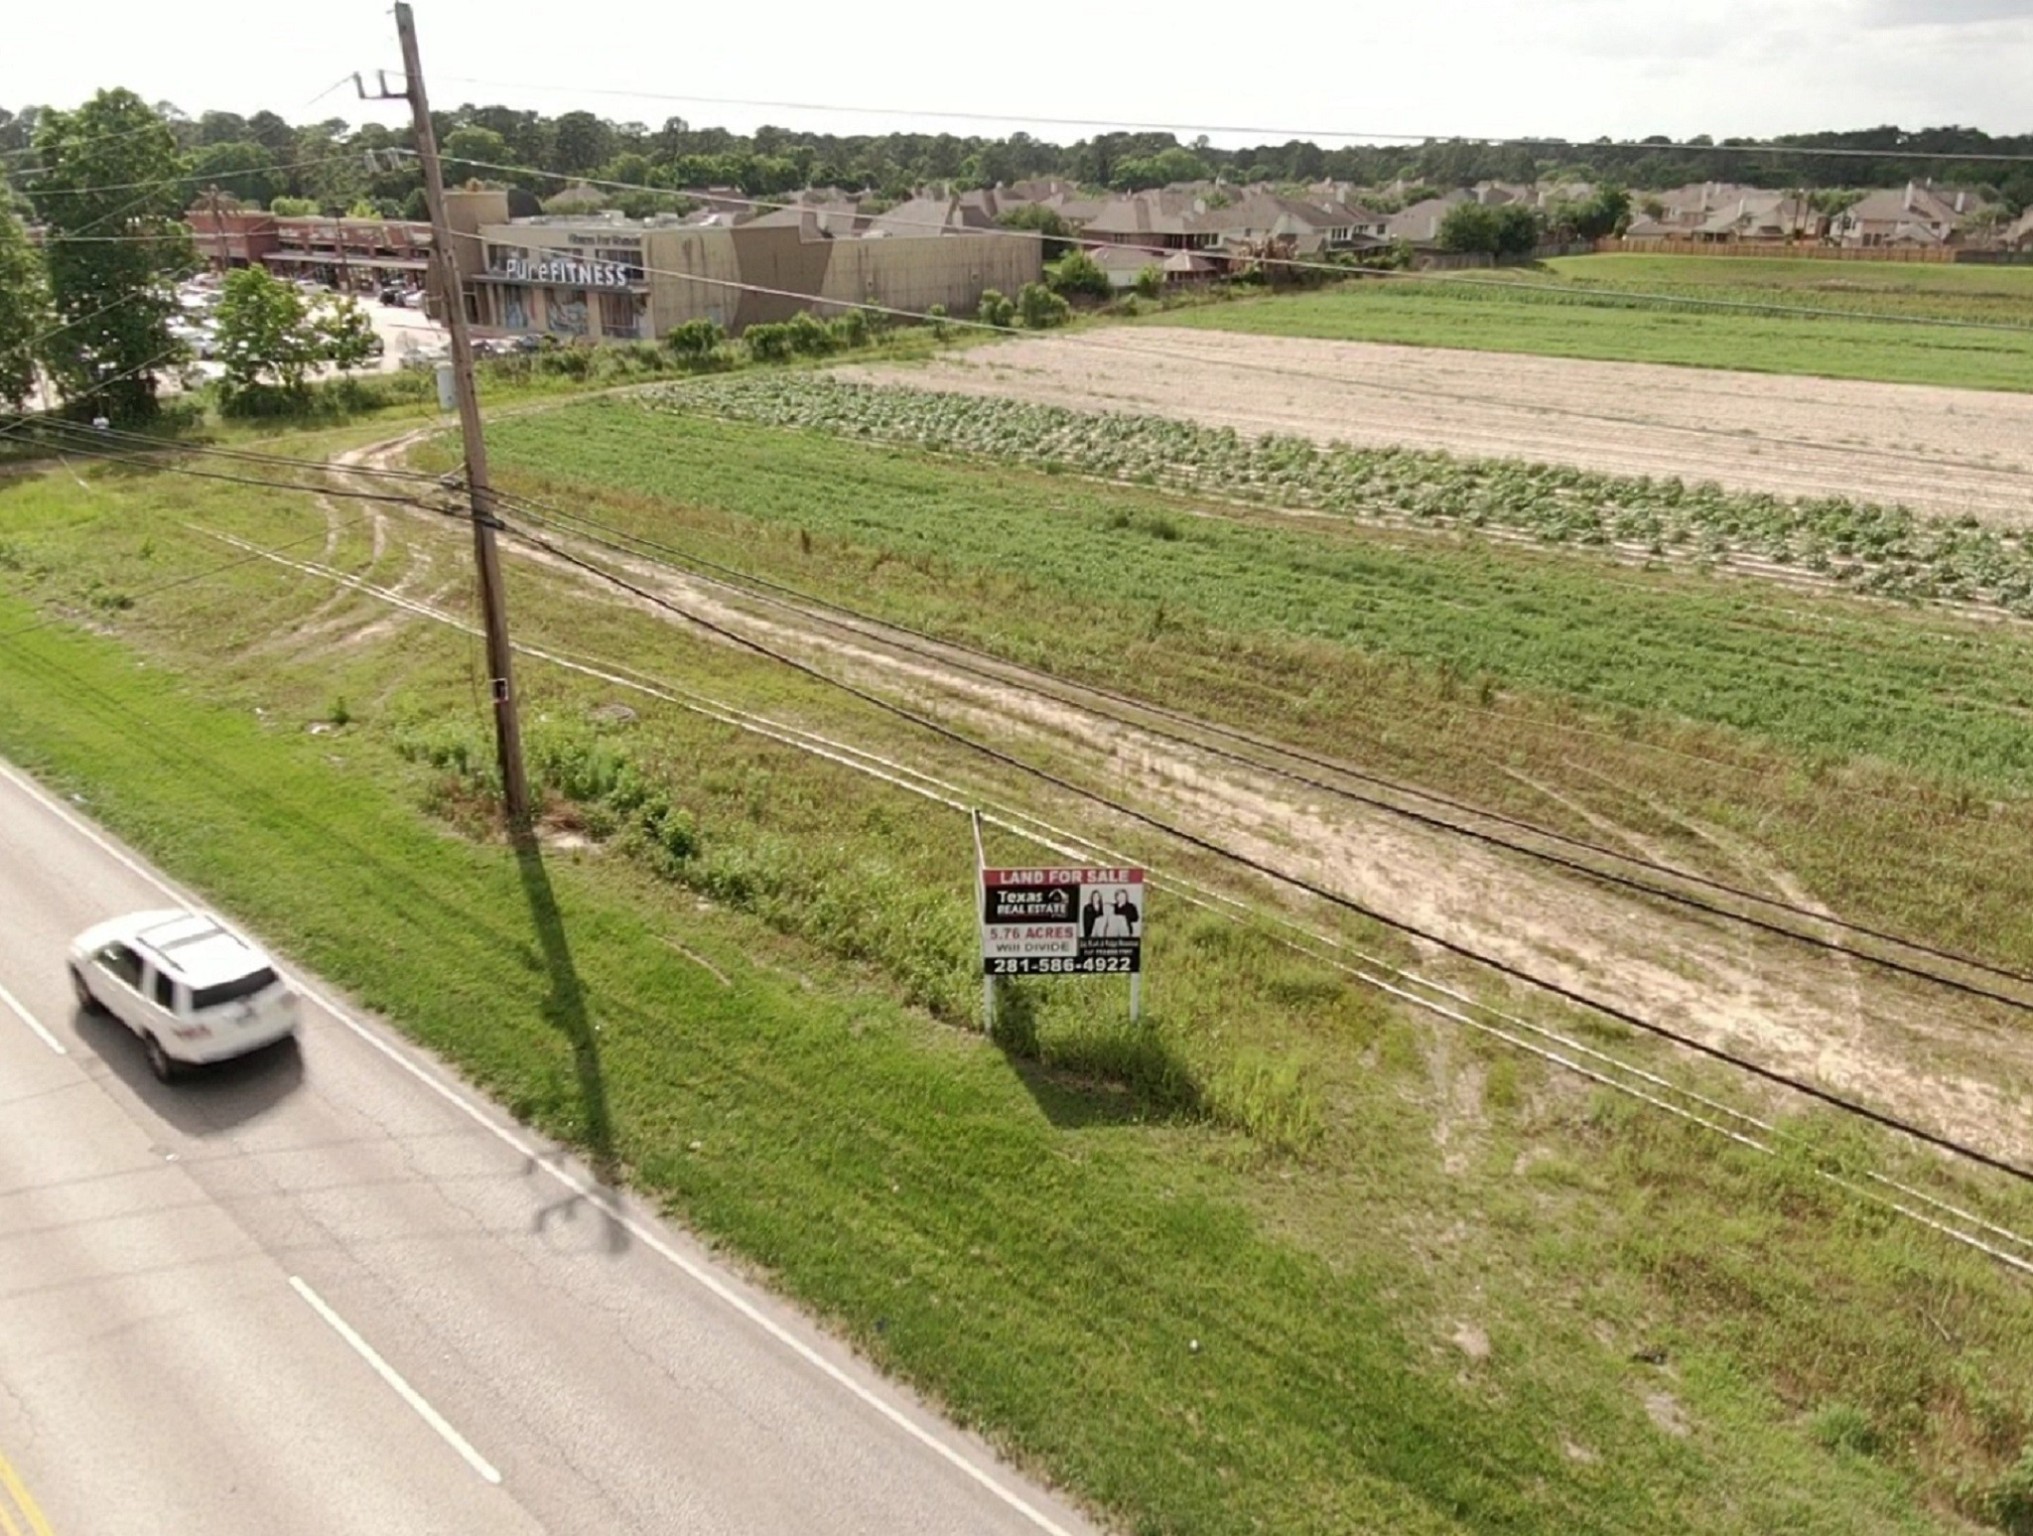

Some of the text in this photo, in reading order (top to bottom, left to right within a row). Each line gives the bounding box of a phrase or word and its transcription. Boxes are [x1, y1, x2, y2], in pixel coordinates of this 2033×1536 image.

[1001, 870, 1129, 884] LAND FOR SALE
[997, 891, 1043, 903] Texas
[997, 903, 1067, 914] REAL ESTATE
[990, 927, 1074, 940] 5.76 ACRES
[1025, 942, 1069, 952] DIVIDE
[994, 957, 1130, 973] 281-586-4922
